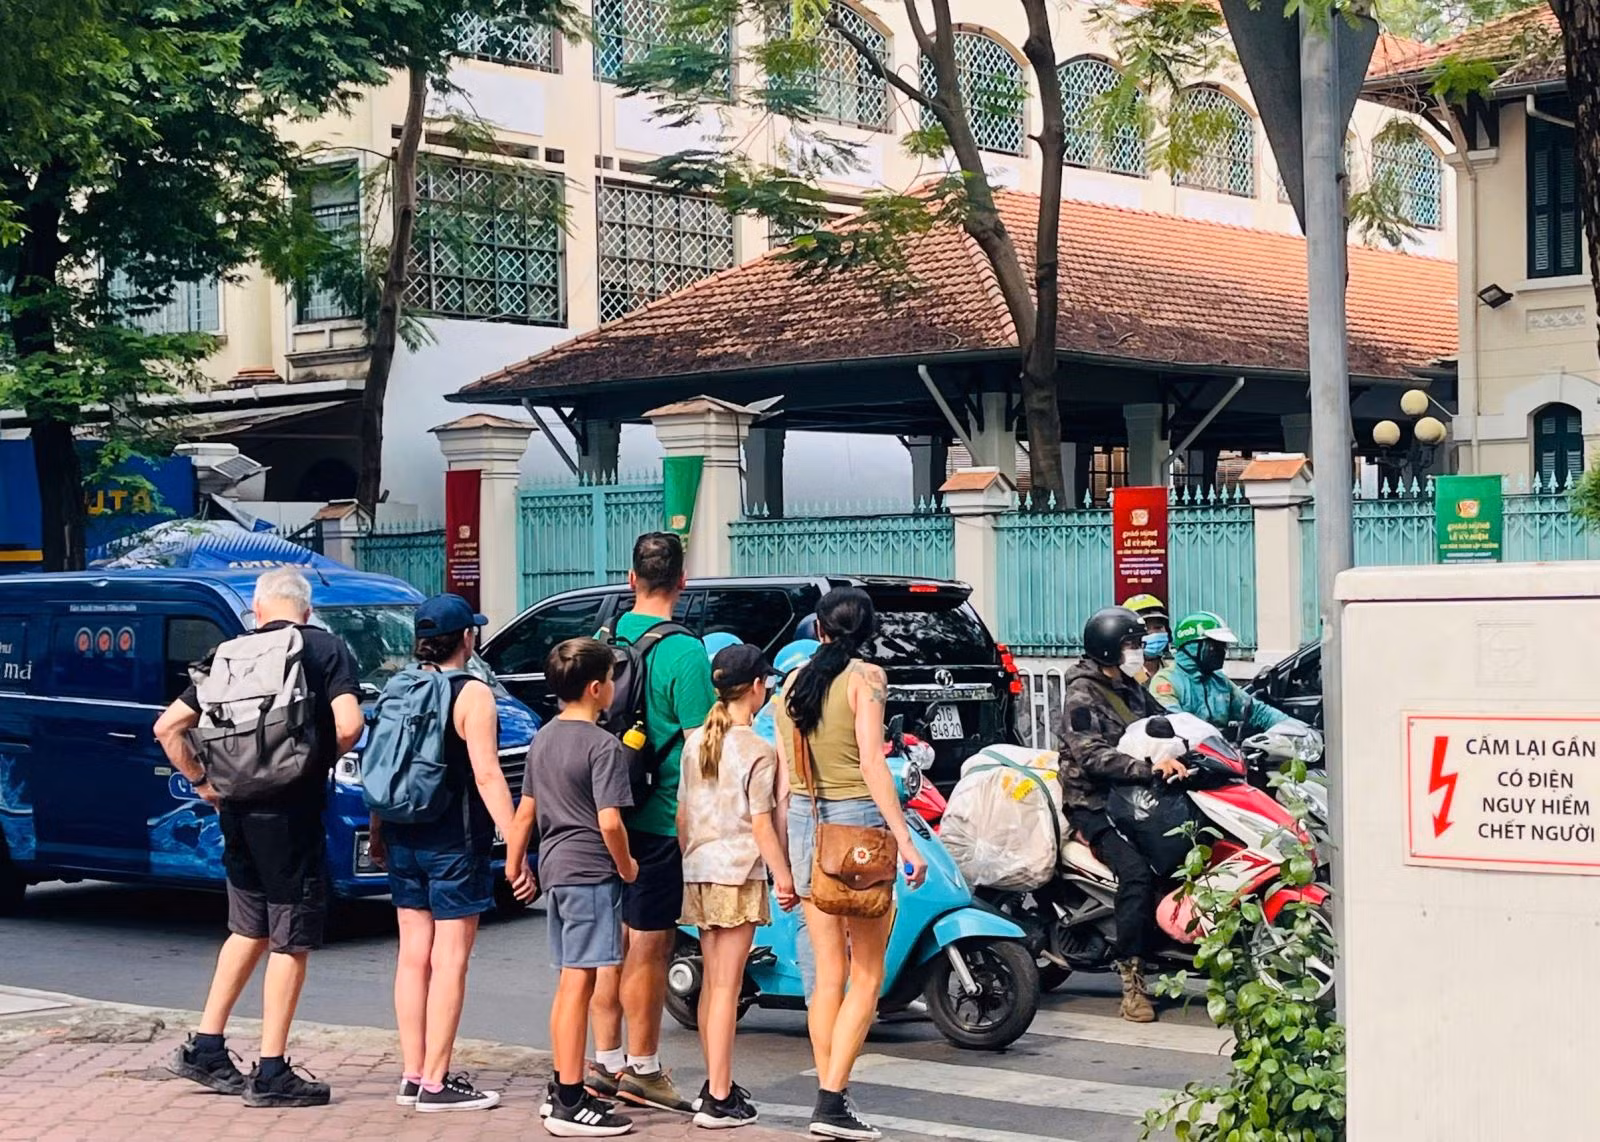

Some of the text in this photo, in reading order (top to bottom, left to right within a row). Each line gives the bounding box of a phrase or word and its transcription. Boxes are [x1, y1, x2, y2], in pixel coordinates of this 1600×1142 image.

[84, 490, 153, 515] UTA
[1177, 626, 1197, 639] Grab
[935, 706, 953, 722] 51G
[931, 722, 962, 738] 94820
[1466, 733, 1596, 761] CẤM LẠI GẦN
[1498, 768, 1573, 793] CÓ ĐIỆN
[1483, 794, 1590, 816] NGUY HIỂM
[1478, 819, 1595, 842] CHẾT NGƯỜI
